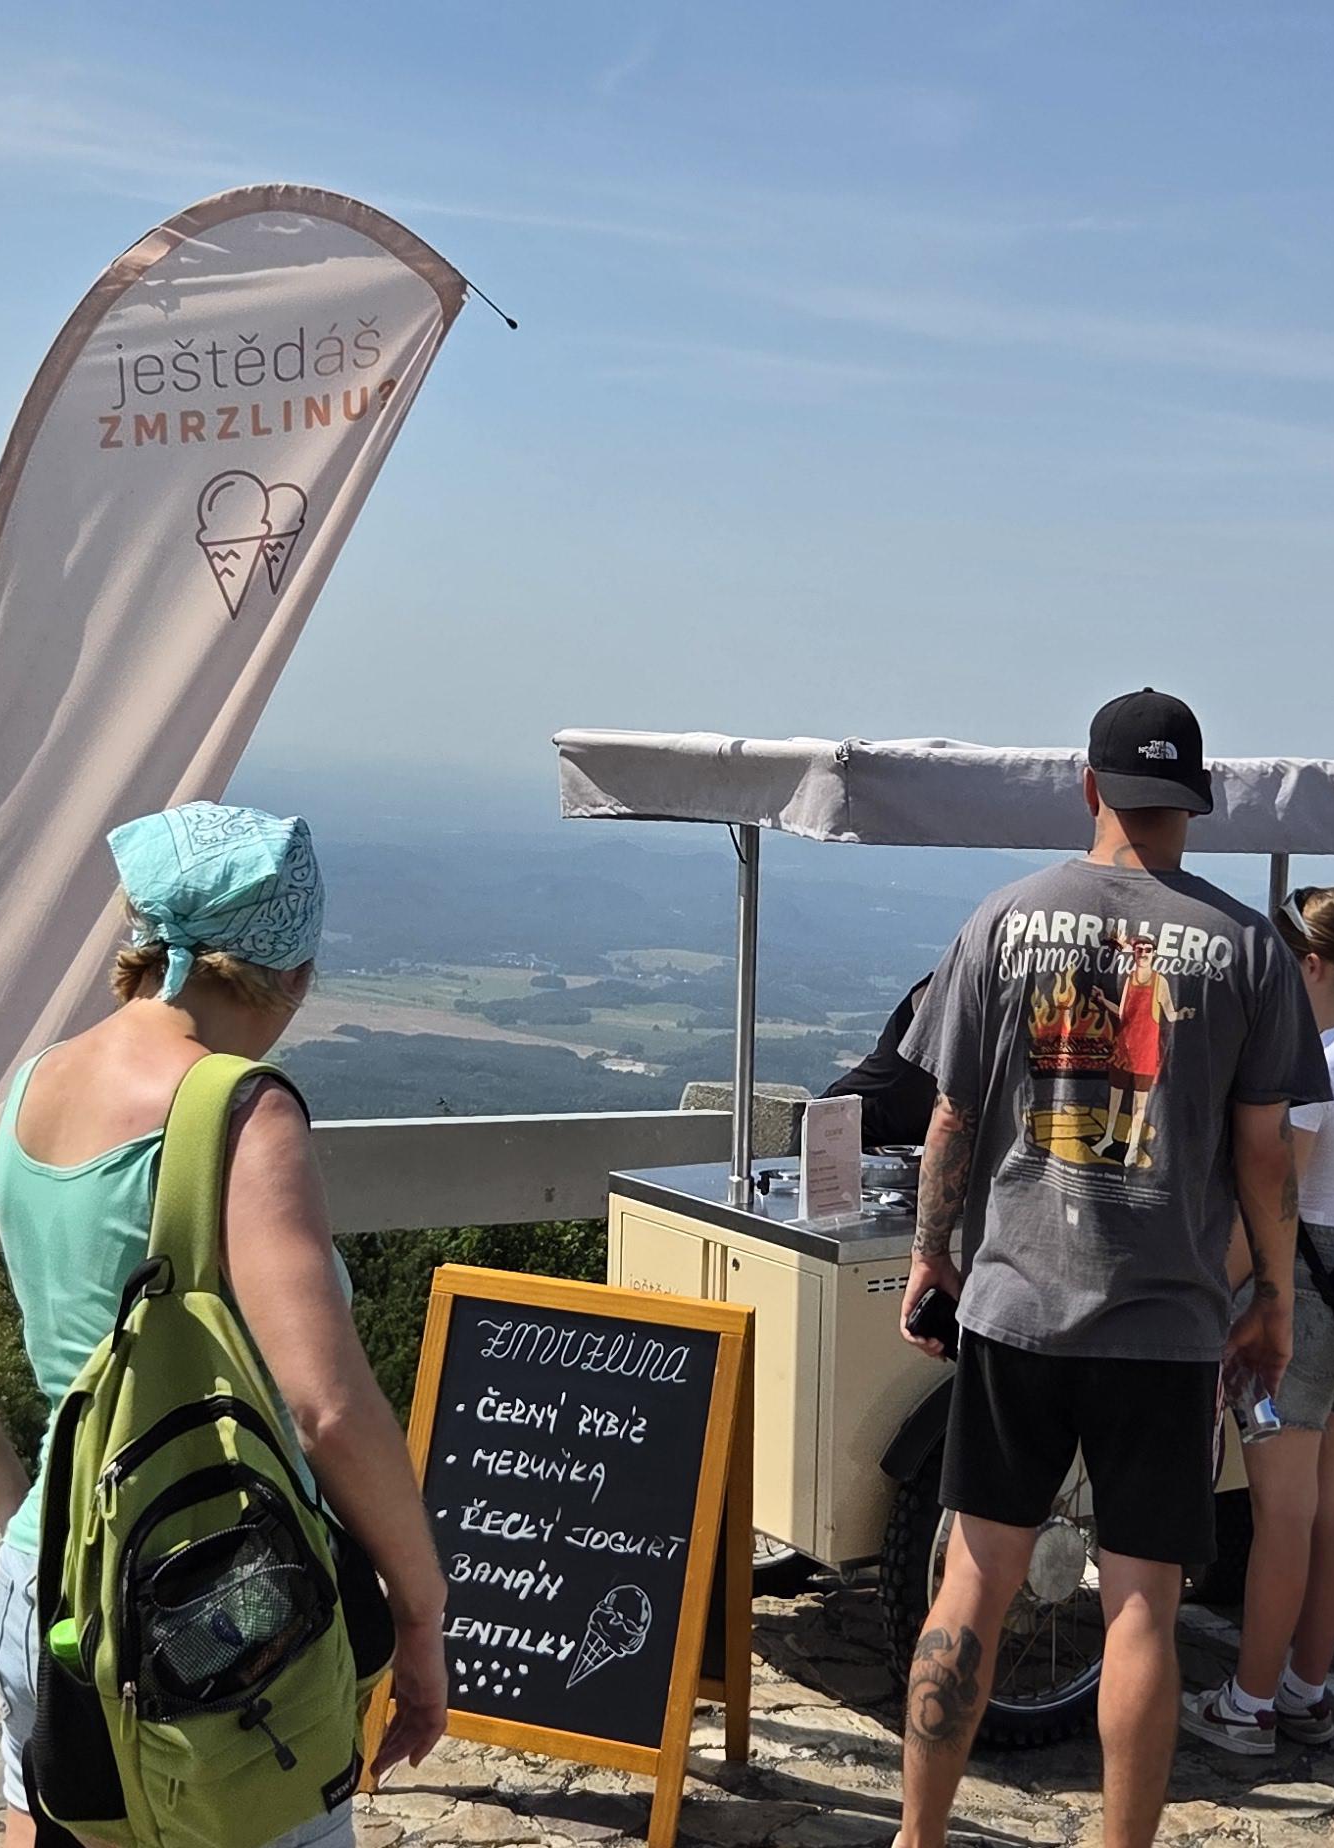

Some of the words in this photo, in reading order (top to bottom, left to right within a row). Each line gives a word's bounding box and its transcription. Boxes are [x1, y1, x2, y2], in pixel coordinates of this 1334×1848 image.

[112, 315, 382, 410] ještědáš
[999, 942, 1092, 982] Summer
[1096, 945, 1225, 982] Chaacters
[476, 1386, 566, 1434] ČERNÝ
[578, 1405, 647, 1443] RYBÍZ
[472, 1448, 606, 1504] MERUŇKA
[460, 1498, 561, 1542] ŘECKÝ
[565, 1526, 686, 1560] JOGURT
[449, 1553, 563, 1601] BANÁN
